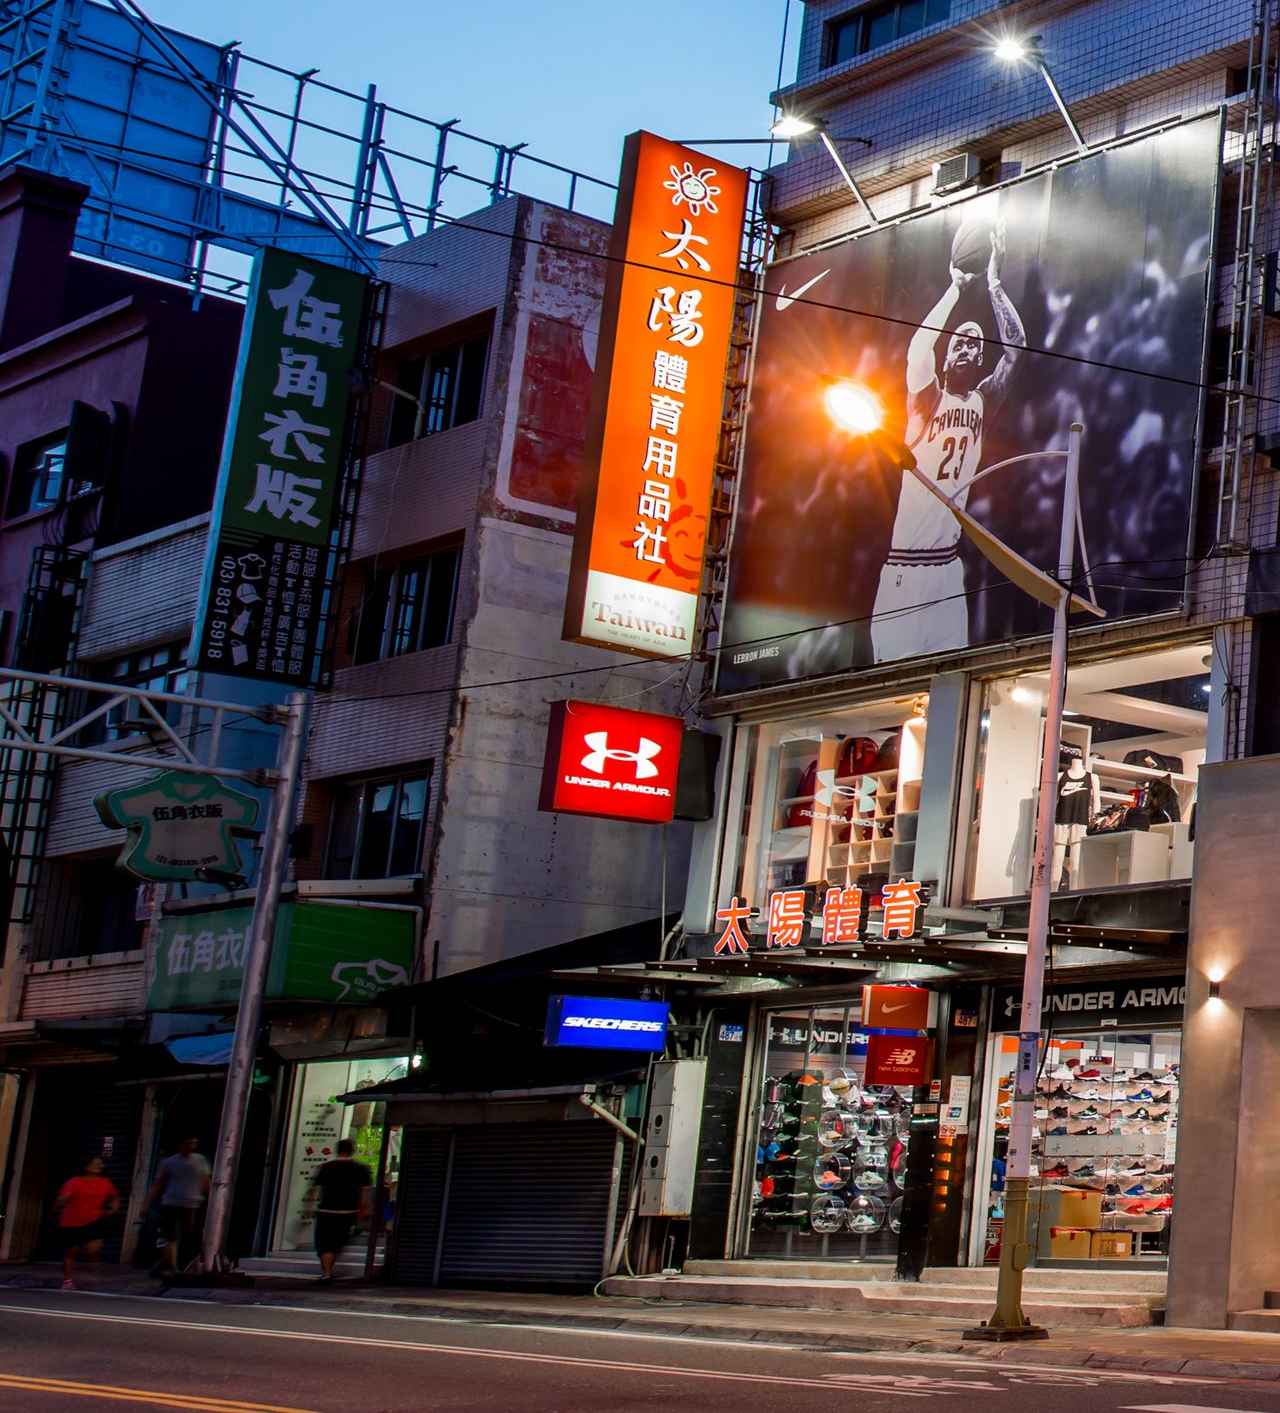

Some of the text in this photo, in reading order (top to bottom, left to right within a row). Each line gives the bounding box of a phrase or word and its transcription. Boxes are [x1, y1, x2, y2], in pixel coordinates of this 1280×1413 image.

[244, 268, 344, 529] 伍角衣版
[937, 436, 968, 480] 23
[591, 601, 687, 641] Taiwan
[621, 630, 641, 642] HEART
[733, 646, 780, 665] LEBRON JAMES
[565, 775, 610, 789] UNDER
[152, 803, 223, 821] 伍角衣版
[714, 878, 922, 956] 太陽體育
[167, 926, 252, 977] 伍角衣
[563, 1016, 663, 1032] SKECHERS
